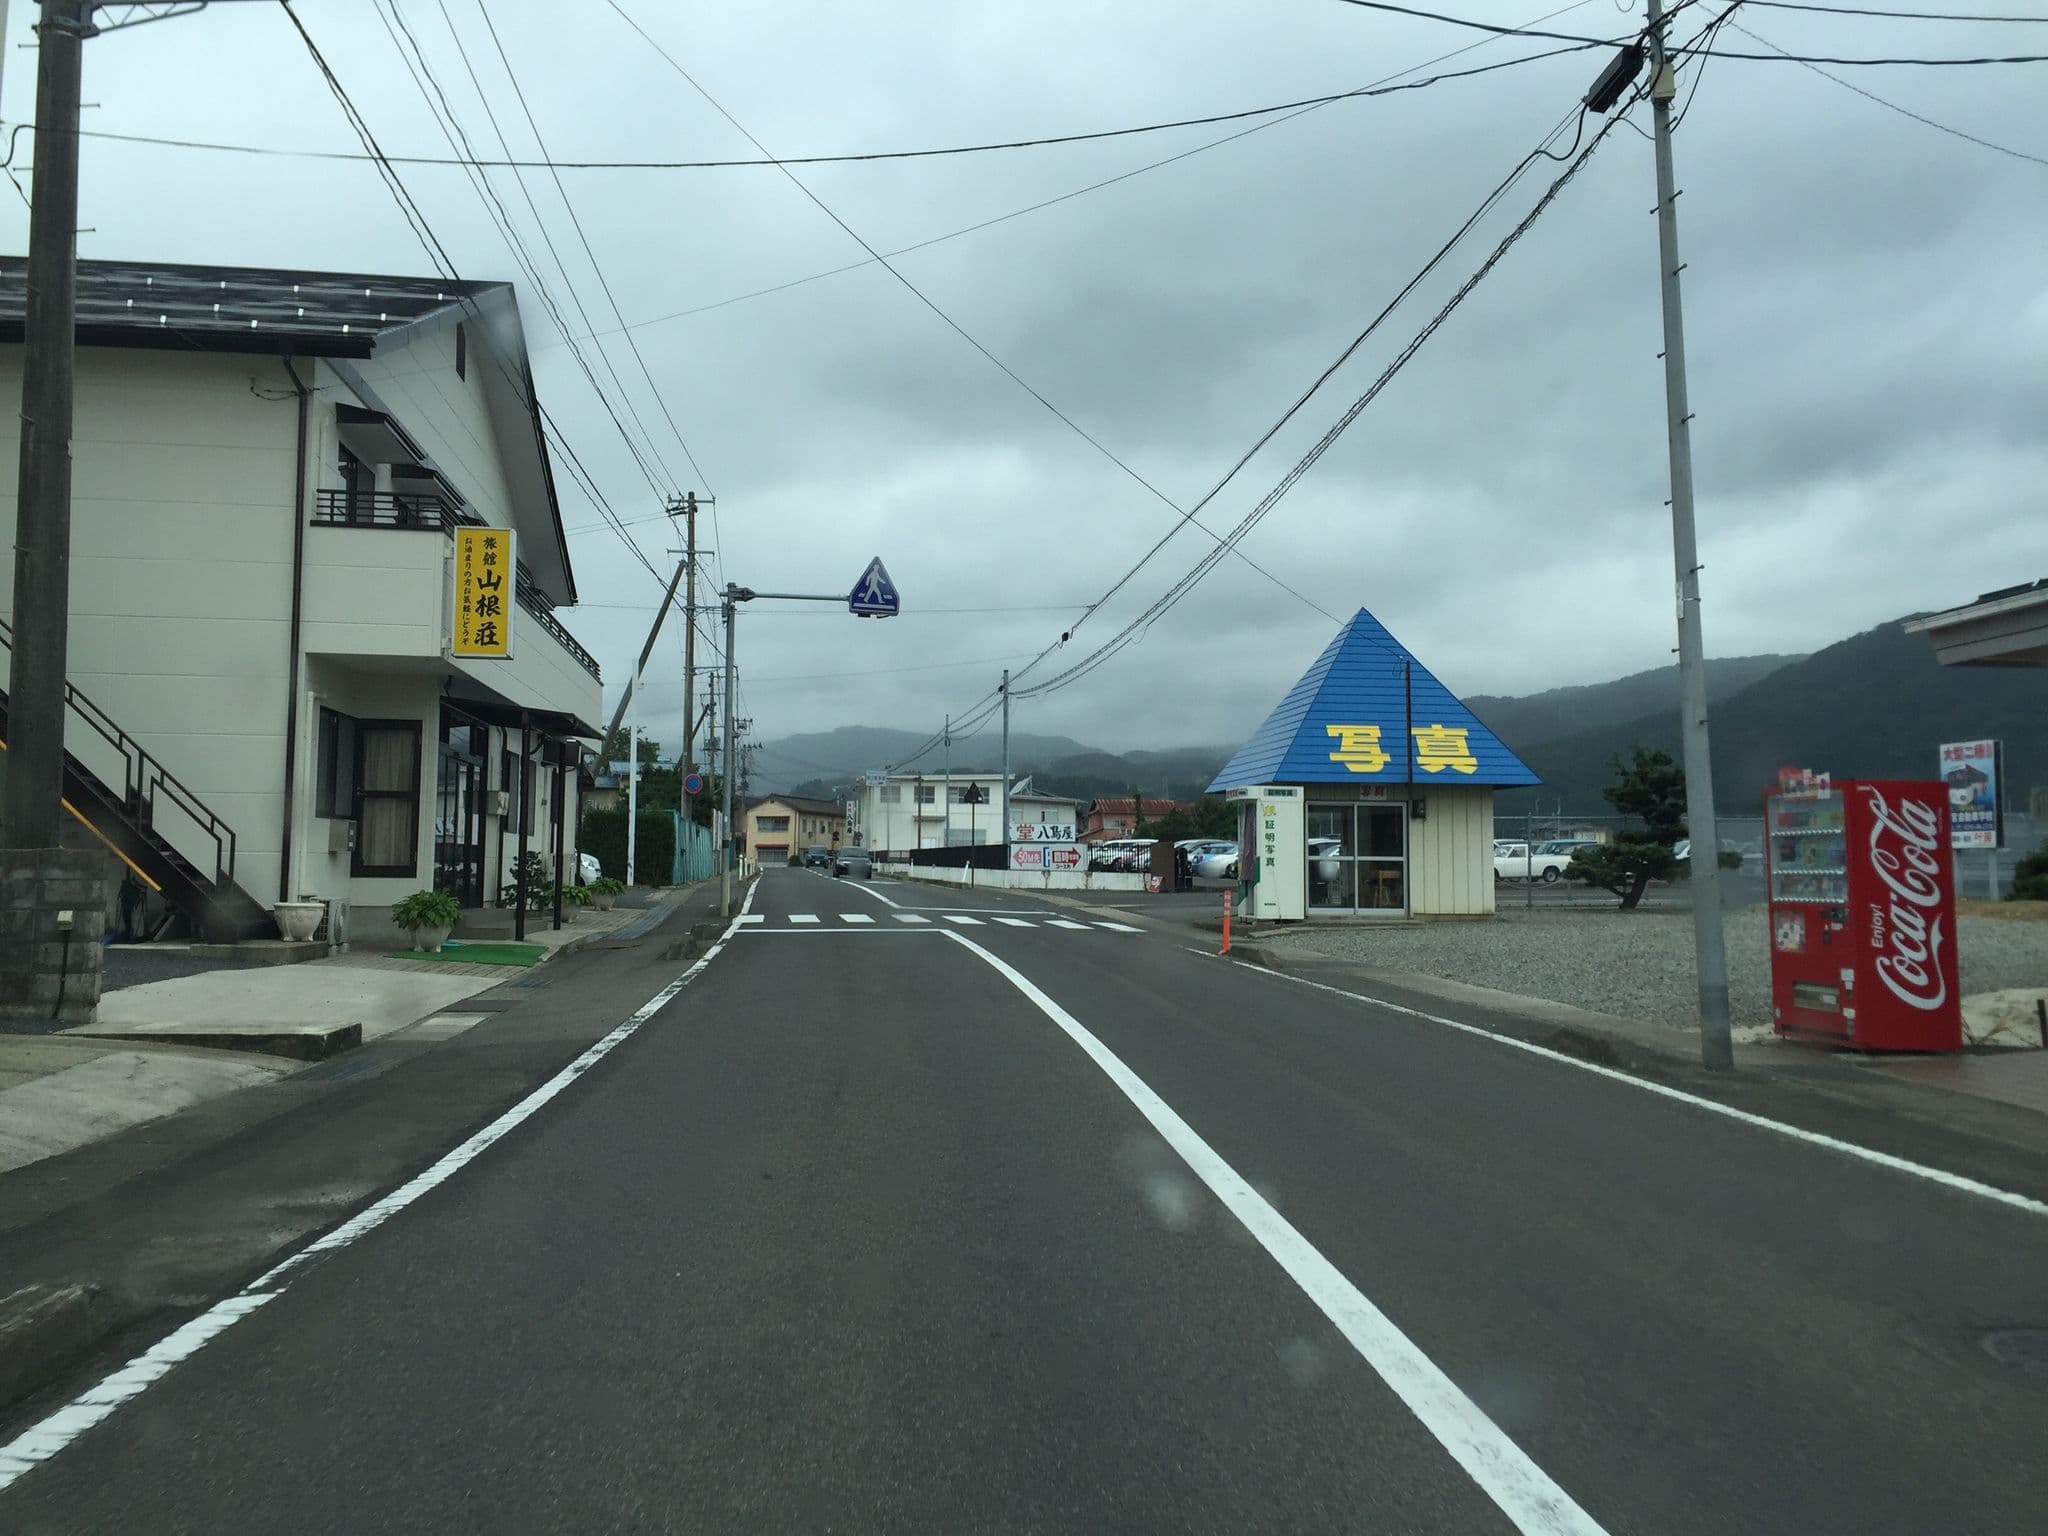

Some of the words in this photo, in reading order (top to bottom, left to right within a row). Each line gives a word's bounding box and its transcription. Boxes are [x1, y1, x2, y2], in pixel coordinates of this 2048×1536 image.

[474, 569, 502, 646] 山根荘
[1326, 724, 1478, 774] 写真
[1037, 825, 1073, 840] 八島屋
[1264, 820, 1276, 867] 証明写真
[1869, 785, 1945, 1010] Coca-Cola
[1870, 904, 1885, 949] Enjoy!
